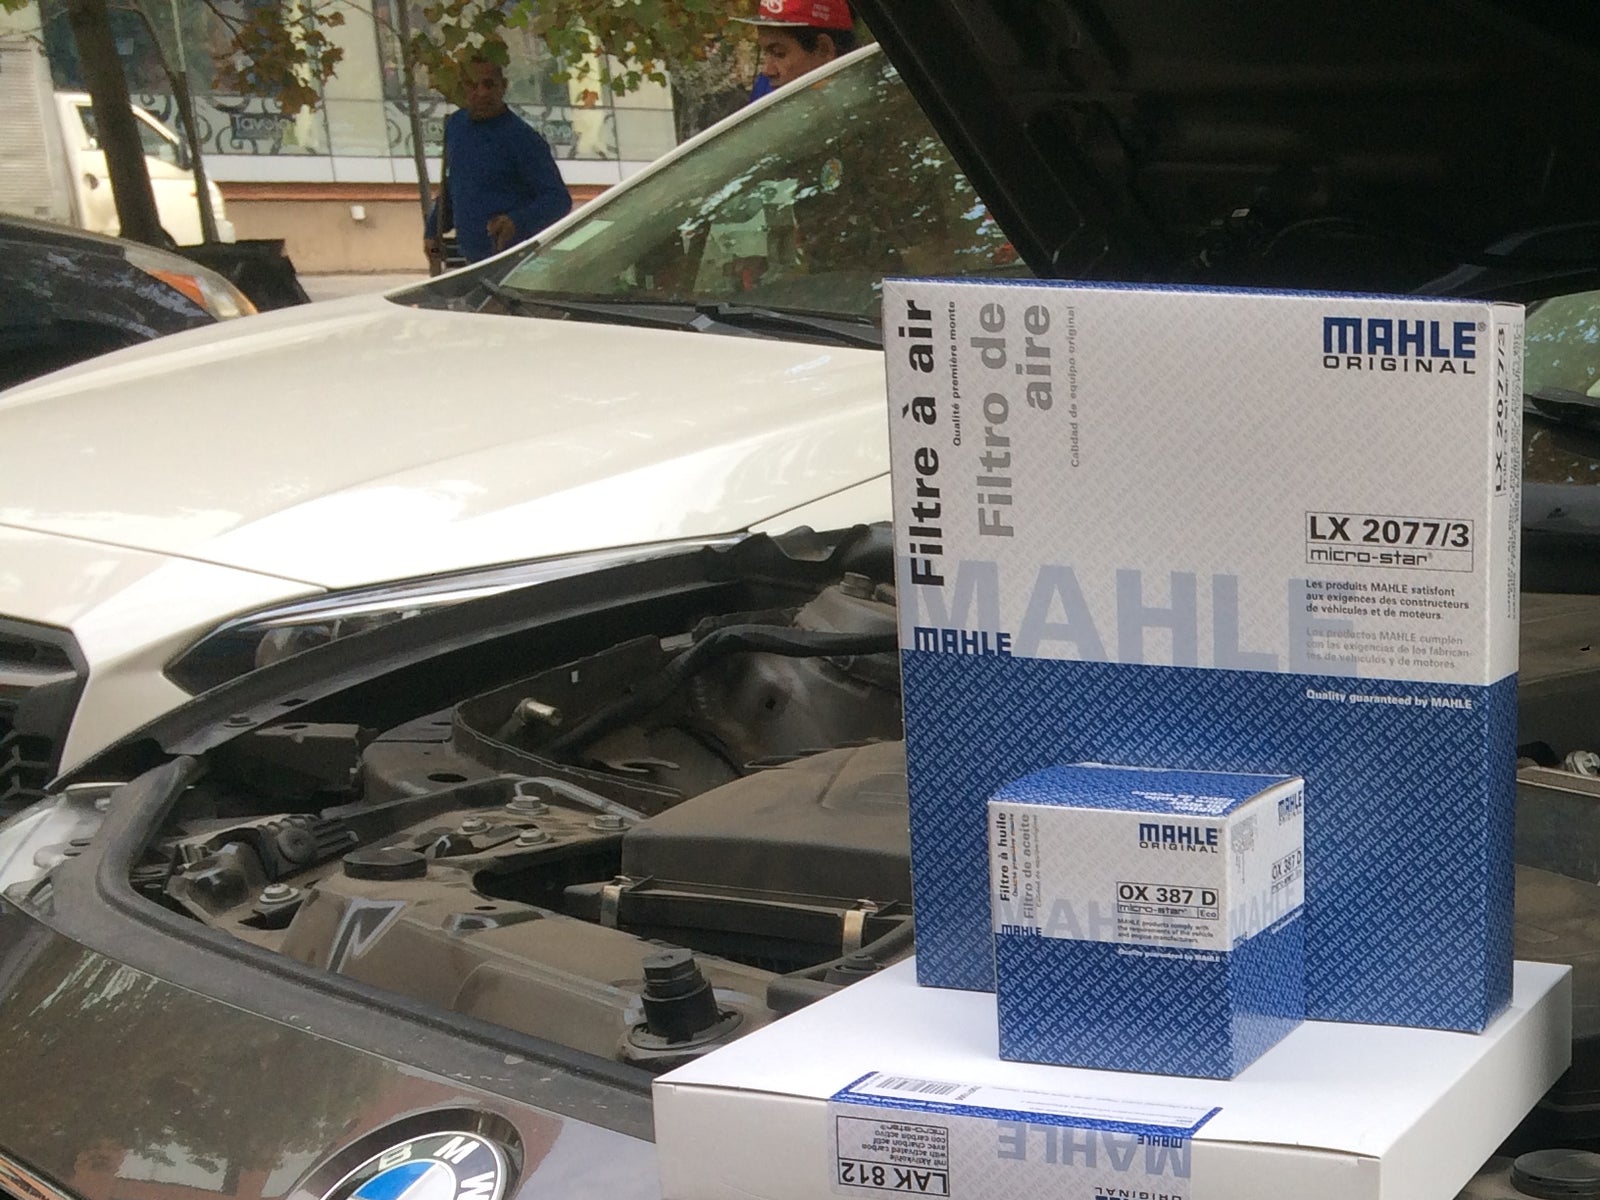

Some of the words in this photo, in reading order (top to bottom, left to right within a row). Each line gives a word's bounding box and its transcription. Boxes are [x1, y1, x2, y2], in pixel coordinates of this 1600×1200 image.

[948, 301, 957, 334] monte
[1066, 305, 1077, 354] original
[898, 299, 935, 373] air
[970, 302, 1007, 370] de
[1323, 316, 1476, 359] MAHLE
[949, 342, 961, 398] première
[1016, 304, 1054, 411] aire
[1323, 355, 1476, 375] ORIGINAL
[1068, 357, 1079, 397] equipo
[902, 396, 937, 426] à
[951, 402, 962, 447] Qualité
[1068, 401, 1078, 416] de
[1069, 420, 1081, 468] Calidad
[976, 392, 1014, 537] Filtro
[908, 446, 945, 587] Filtre
[1310, 515, 1351, 542] LX
[1362, 519, 1470, 548] 2077/3
[1310, 546, 1428, 566] micro-star
[1306, 579, 1323, 589] Les
[1326, 581, 1368, 593] produits
[1370, 583, 1408, 594] MAHLE
[1411, 585, 1456, 597] satisfont
[1306, 593, 1324, 601] aux
[1327, 593, 1376, 604] exigences
[1379, 596, 1398, 605] des
[1400, 599, 1470, 609] constructeurs
[900, 557, 1359, 678] MAHLE
[1306, 603, 1319, 612] de
[1321, 604, 1368, 616] véhicules
[1371, 608, 1381, 616] et
[1384, 608, 1397, 617] de
[913, 627, 1011, 658] MAHLE
[1306, 641, 1324, 649] con
[1343, 643, 1394, 654] exigencias
[1397, 645, 1409, 654] de
[1412, 645, 1427, 655] los
[1326, 629, 1377, 641] productos
[1379, 631, 1417, 642] MAHLE
[1419, 634, 1463, 646] cumplen
[1324, 652, 1337, 662] de
[1398, 657, 1410, 667] de
[1011, 690, 1043, 724] MAHLE
[1124, 683, 1156, 717] MAHLE
[1306, 689, 1346, 701] Quality
[1349, 692, 1412, 706] guaranteed
[1415, 695, 1428, 708] by
[1431, 697, 1473, 710] MAHLE
[1206, 707, 1238, 741] MAHLE
[1337, 718, 1372, 752] MAHLE
[940, 801, 972, 835] MAHLE
[996, 813, 1008, 847] huile
[1139, 823, 1218, 846] MAHLE
[1139, 842, 1218, 854] ORIGINAL
[1438, 831, 1473, 865] MAHLE
[999, 865, 1010, 901] Filtre
[1022, 861, 1032, 878] de
[1023, 883, 1034, 919] Filtro
[1119, 885, 1149, 901] OX
[1156, 888, 1193, 905] 387
[1201, 891, 1217, 906] D
[1373, 892, 1408, 926] MAHLE
[1200, 909, 1217, 918] Eco
[1002, 924, 1042, 938] MAHLE
[1041, 976, 1076, 1010] MAHLE
[1439, 965, 1474, 999] MAHLE
[1109, 983, 1144, 1017] MAHLE
[997, 1120, 1192, 1179] MAHLE
[1137, 1134, 1183, 1149] MAHLE
[841, 1162, 885, 1186] 812
[894, 1167, 947, 1194] LAK
